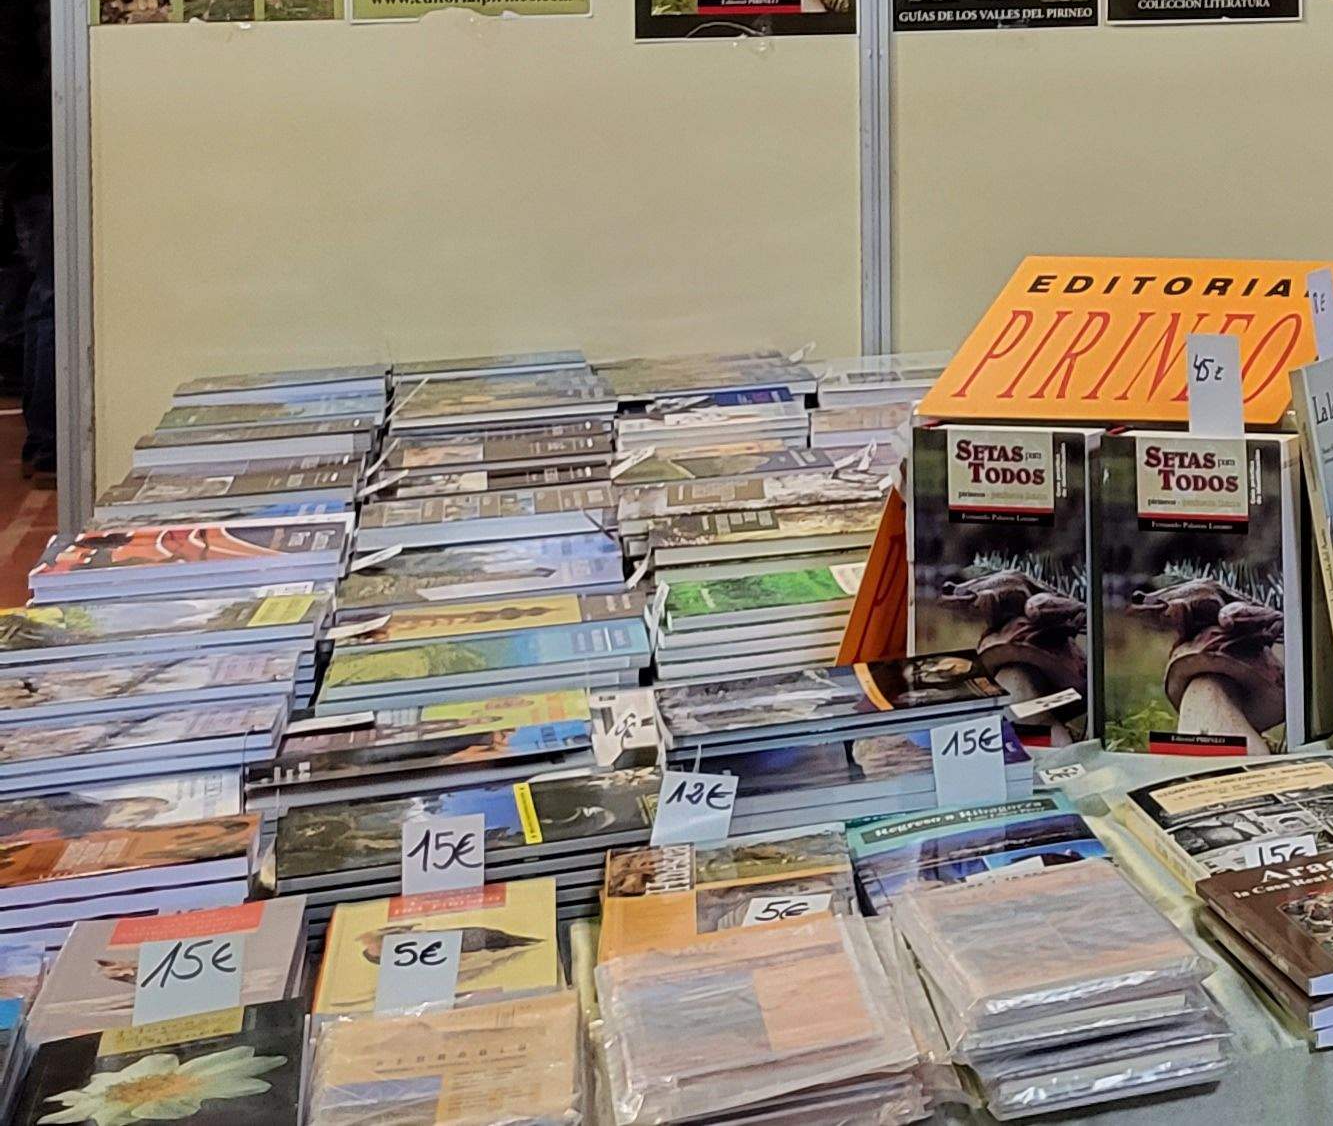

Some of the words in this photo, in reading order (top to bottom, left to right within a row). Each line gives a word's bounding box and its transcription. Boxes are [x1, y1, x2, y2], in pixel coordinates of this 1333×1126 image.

[899, 8, 936, 23] GUÍAS
[937, 9, 955, 22] DE
[956, 9, 978, 22] LOS
[979, 8, 1021, 21] VALLES
[1022, 8, 1045, 20] DEL
[1047, 7, 1093, 20] PIRINEO
[1026, 275, 1311, 298] EDITORIA
[951, 310, 1303, 404] PIRINO
[1312, 396, 1328, 424] La
[955, 439, 1025, 463] SETAS
[1025, 450, 1042, 461] para
[1144, 447, 1216, 470] SETAS
[1217, 458, 1236, 468] para
[968, 462, 1046, 485] TODOS
[1157, 469, 1240, 493] TODOS
[941, 726, 1004, 757] 15€
[407, 829, 484, 872] 15€
[1258, 843, 1308, 868] 15€
[1233, 888, 1250, 900] la
[1251, 881, 1291, 895] Casa
[1293, 873, 1328, 888] Real
[753, 900, 812, 922] 5€
[140, 940, 238, 989] 15€
[393, 940, 447, 967] 5€
